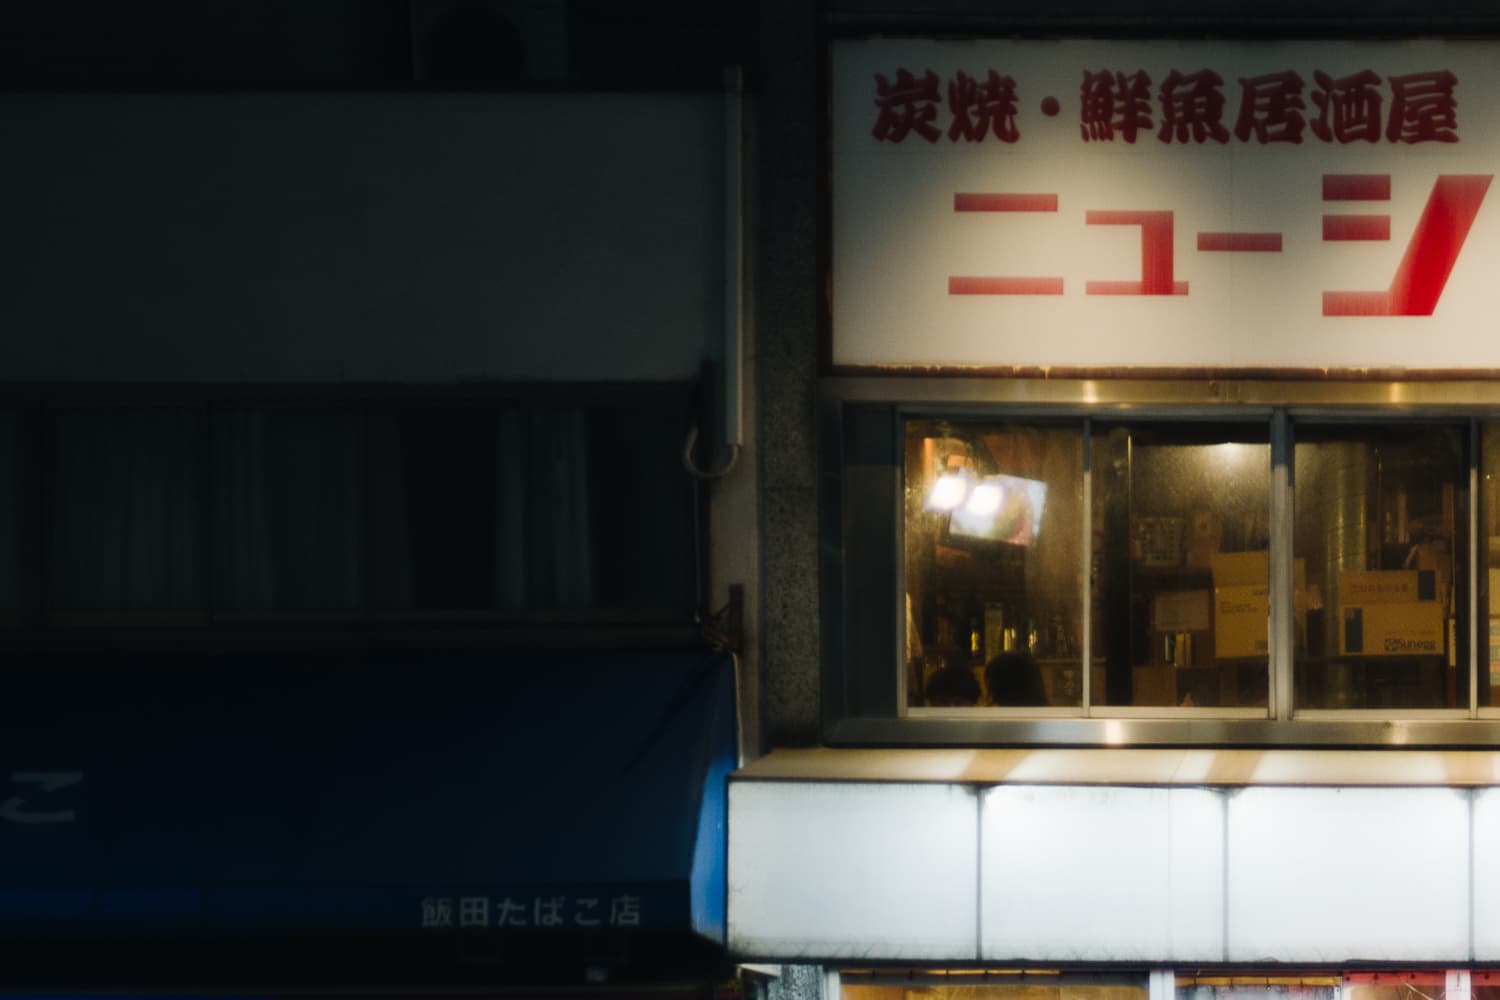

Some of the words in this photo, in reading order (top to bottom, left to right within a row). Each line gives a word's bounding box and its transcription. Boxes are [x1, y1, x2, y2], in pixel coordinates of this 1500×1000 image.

[872, 67, 1459, 144] 炭焼・鮮魚居酒屋
[420, 894, 641, 928] 飯田たばこ店
